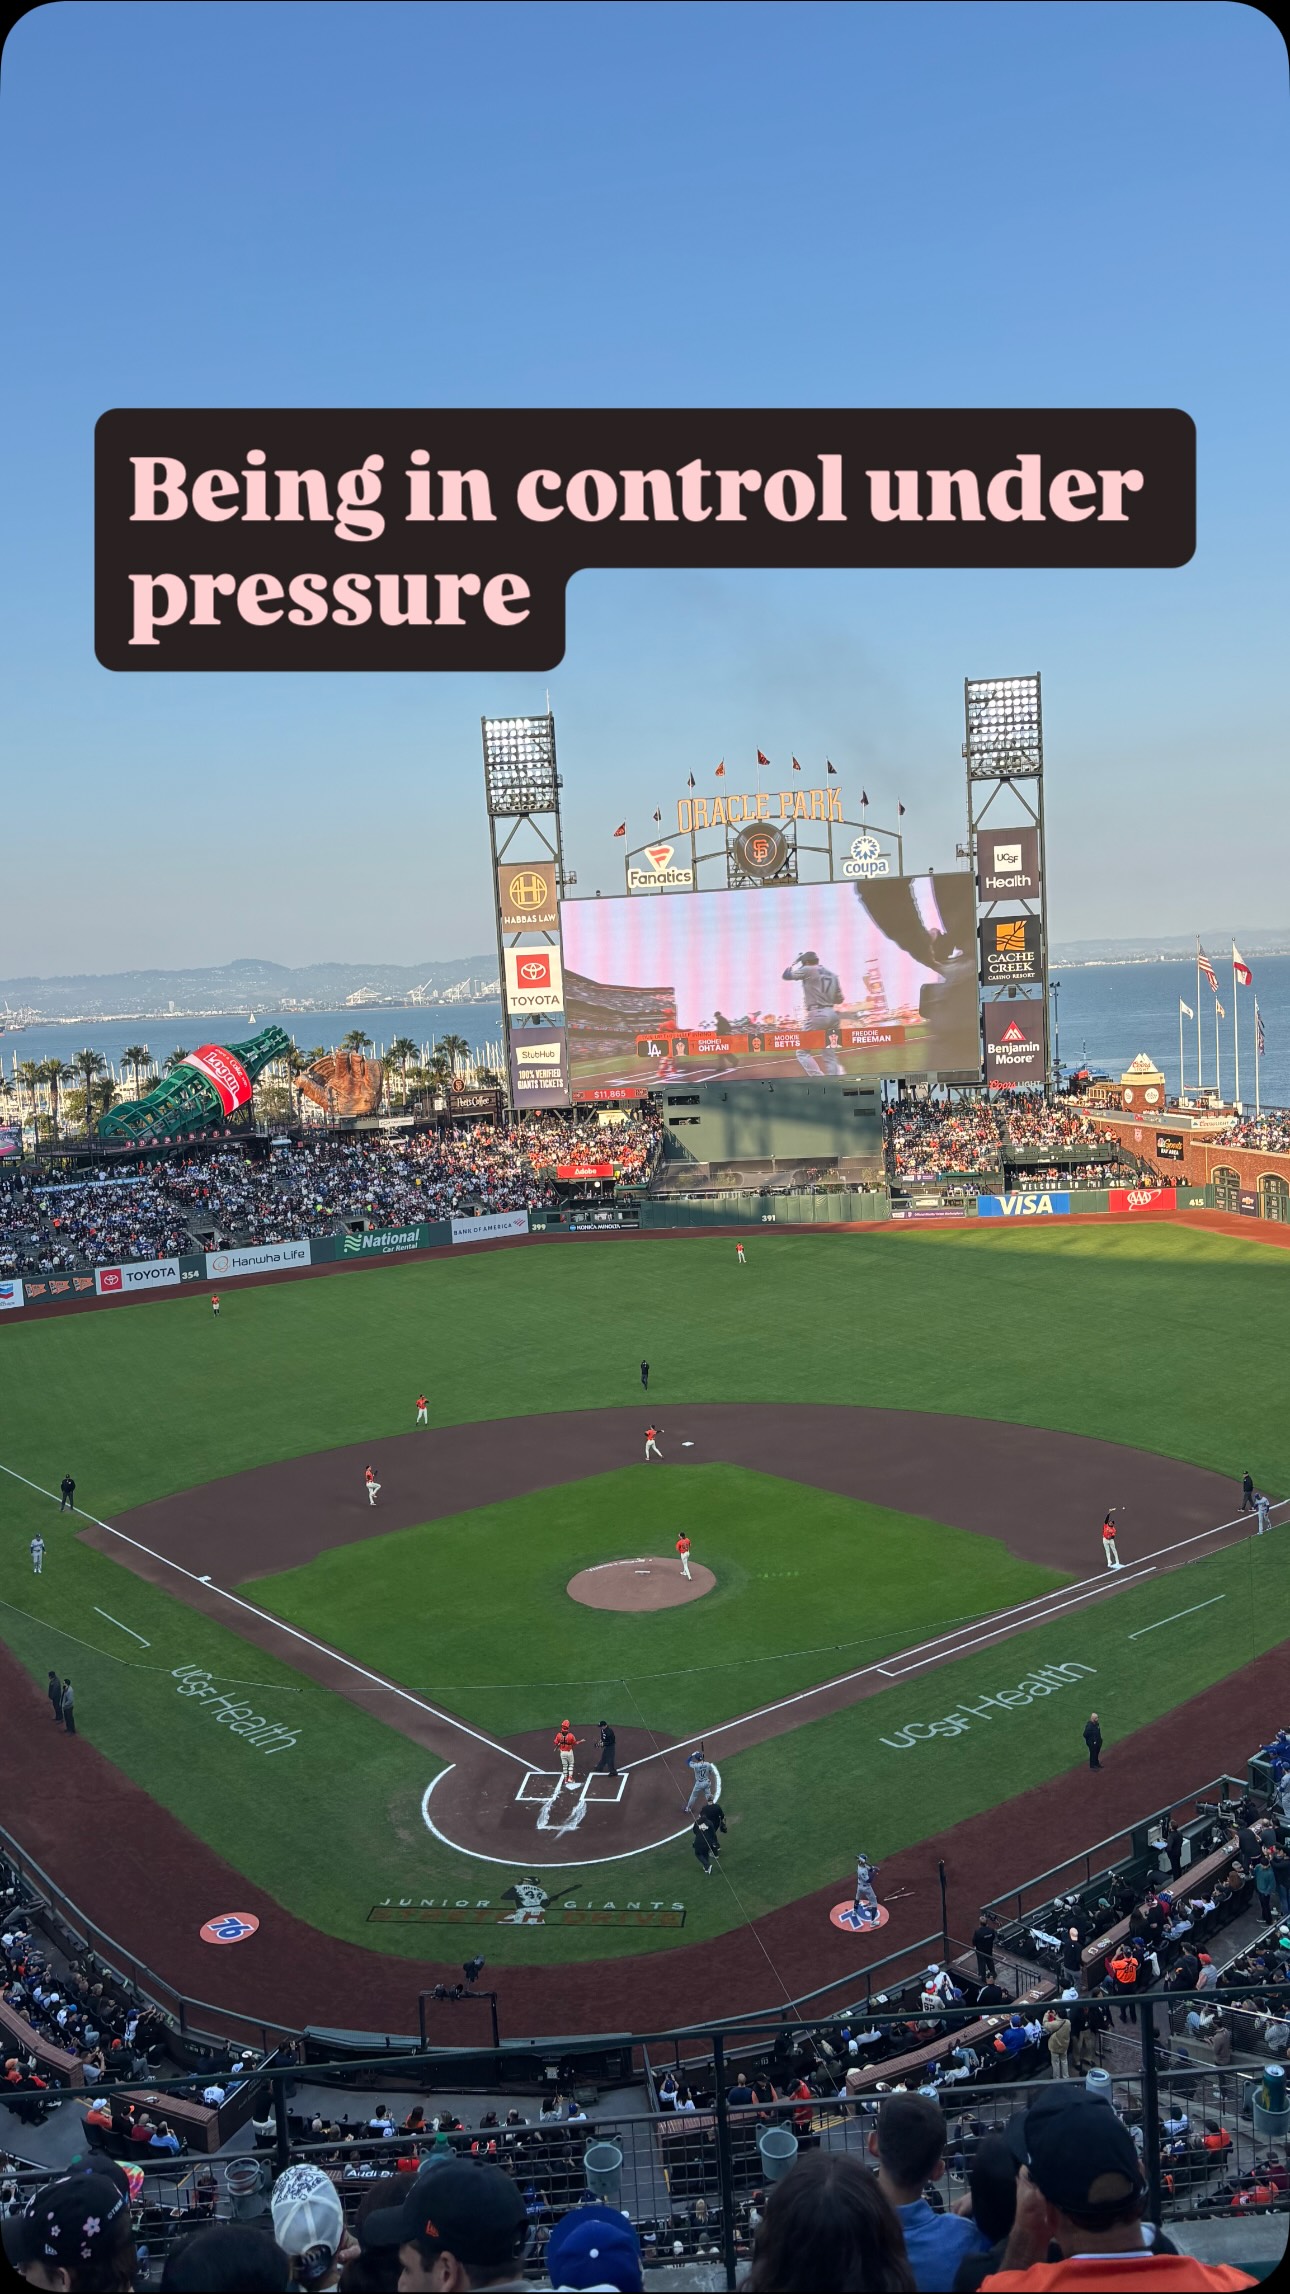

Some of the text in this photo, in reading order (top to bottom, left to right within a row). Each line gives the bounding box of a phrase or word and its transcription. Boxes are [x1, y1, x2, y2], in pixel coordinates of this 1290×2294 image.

[678, 786, 844, 833] ORACLE PARK
[996, 853, 1019, 864] UCSF
[845, 861, 886, 876] coupa
[630, 869, 691, 885] Fanatics
[986, 875, 1031, 888] Health
[504, 913, 556, 924] HABBAS LAW
[987, 952, 1035, 963] CACHE
[989, 962, 1033, 973] CREEK
[510, 994, 560, 1006] TOYOTA
[774, 1040, 800, 1048] BETTS
[852, 1035, 891, 1044] FREEMAN
[647, 1040, 662, 1057] LA
[698, 1043, 729, 1052] OHTANI
[987, 1041, 1039, 1056] Benjamin
[521, 1050, 555, 1059] StubHub
[203, 1052, 240, 1094] Logan
[518, 1068, 561, 1080] 100% VERIFIED
[517, 1078, 564, 1090] GIANTS TICKETS
[989, 1080, 1041, 1090] Coors LIGHT
[594, 1090, 626, 1099] $11,865
[1021, 1181, 1062, 1191] WELCOME
[1069, 1181, 1079, 1190] TO
[1130, 1191, 1150, 1204] AAA
[1189, 1199, 1204, 1207] 415
[995, 1194, 1054, 1215] VISA
[761, 1214, 776, 1222] 391
[453, 1228, 472, 1236] BANK
[482, 1223, 512, 1233] AMERICA
[531, 1223, 546, 1231] 399
[362, 1228, 419, 1248] National
[395, 1242, 418, 1252] Rental
[232, 1249, 305, 1267] Hanwha Life
[126, 1267, 176, 1282] TOYOTA
[181, 1270, 200, 1280] 354
[171, 1664, 302, 1754] UCSF Health
[879, 1662, 1097, 1748] UCSF Health
[379, 1898, 685, 1910] JUNIOR GIANTS
[207, 1917, 254, 1939] 76
[347, 2169, 377, 2177] Audi
